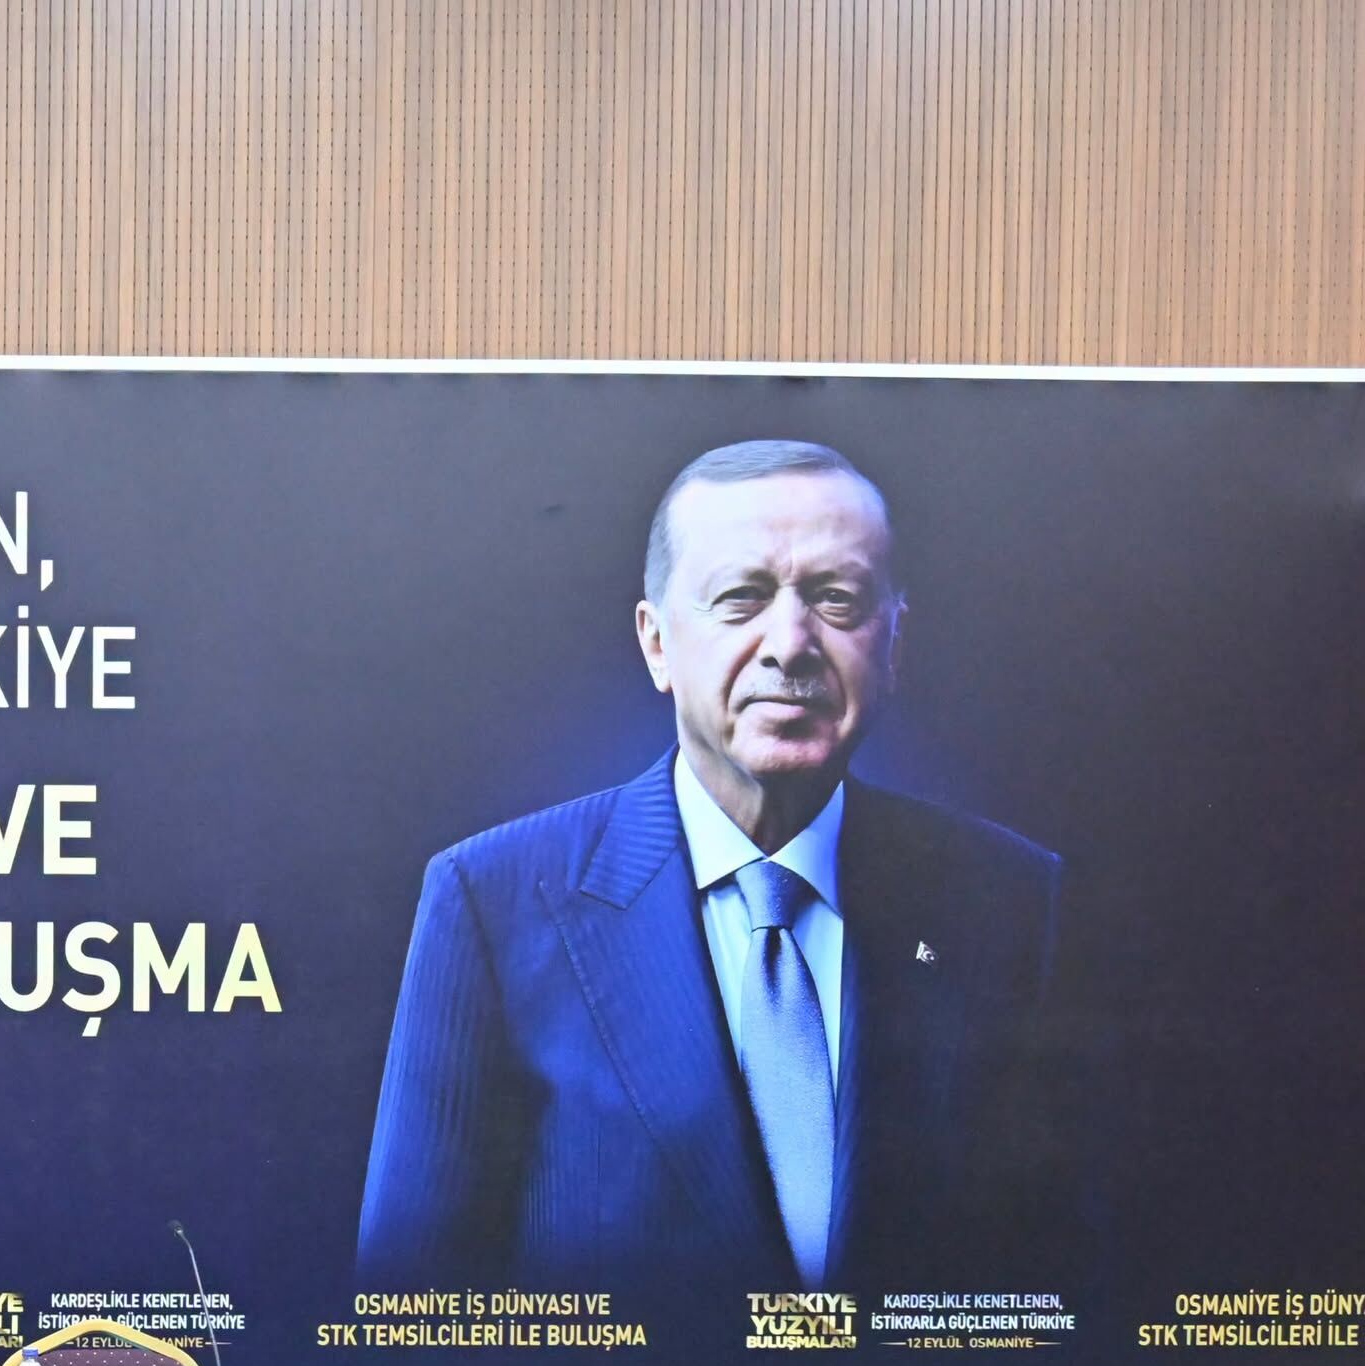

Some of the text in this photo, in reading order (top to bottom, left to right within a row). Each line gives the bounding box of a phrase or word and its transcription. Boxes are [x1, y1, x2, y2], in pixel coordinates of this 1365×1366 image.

[51, 1290, 234, 1314] KARDEŞLİKLE KENETLENEN,
[354, 1288, 611, 1321] OSMANİYE İŞ DÜNYASI VE
[883, 1291, 1064, 1313] KARDEŞLİKLE KENETLENEN,
[1175, 1288, 1305, 1321] OSMANİYE İŞ
[871, 1311, 1076, 1334] İSTİKRARLA GÜÇLENEN TÜRKİYE
[1138, 1319, 1360, 1346] STK TEMSİLCİLERİ İLE
[316, 1319, 647, 1352] STK TEMSİLCİLERİ İLE BULUŞMA
[906, 1335, 1034, 1349] 12 EYLÜL OSMANİYE
